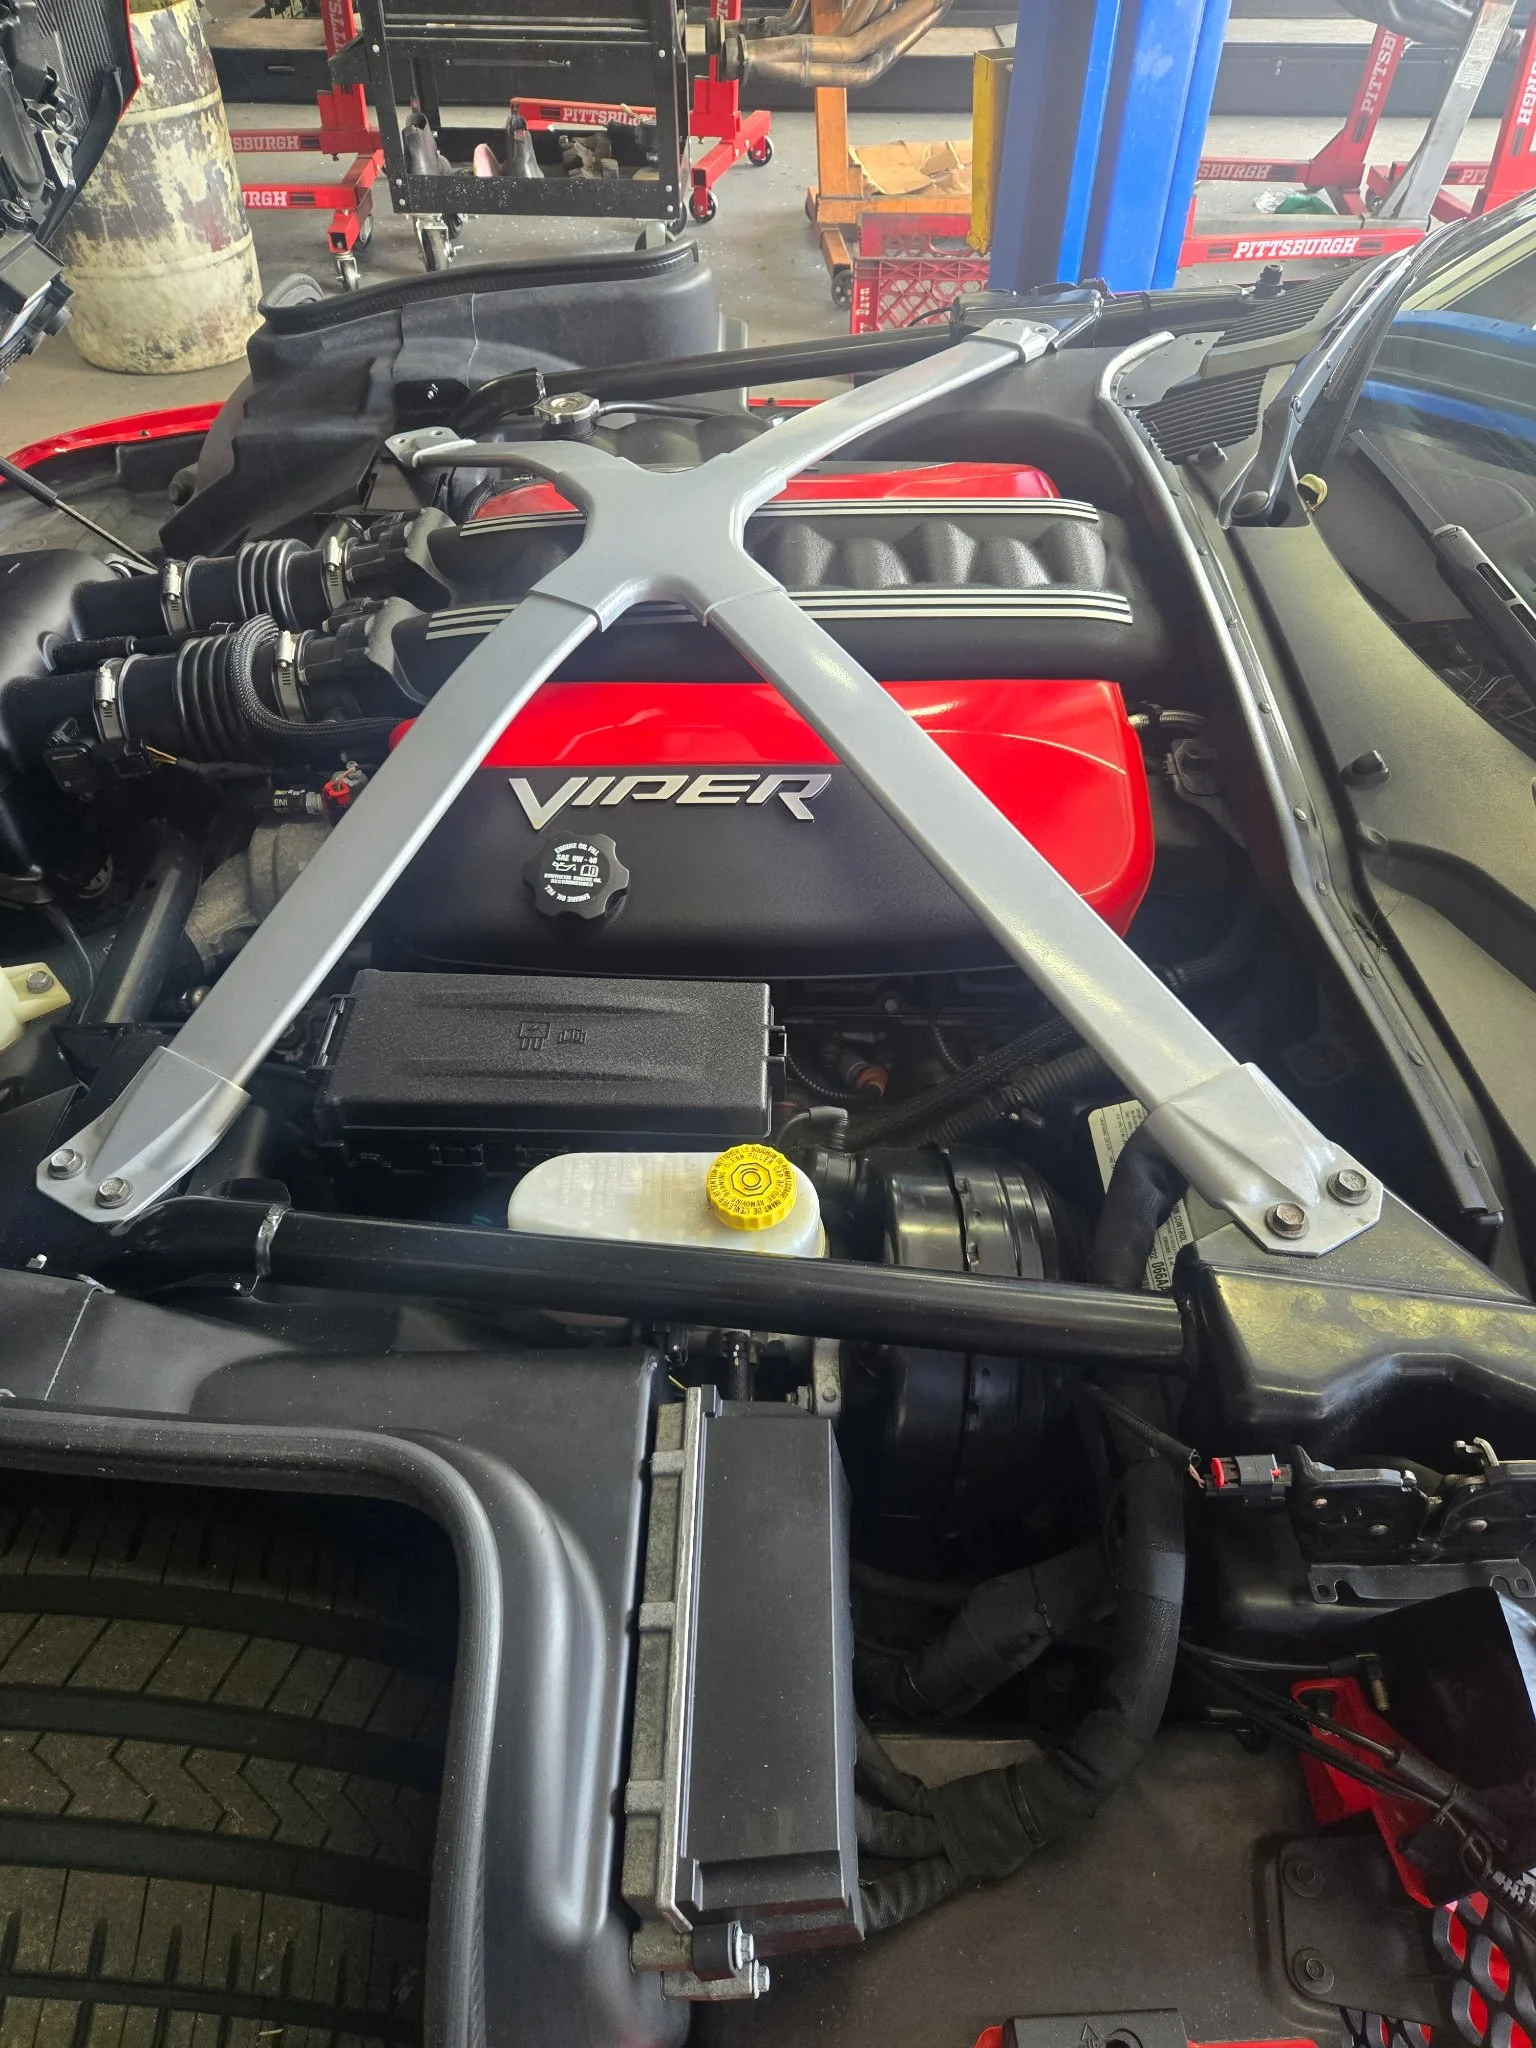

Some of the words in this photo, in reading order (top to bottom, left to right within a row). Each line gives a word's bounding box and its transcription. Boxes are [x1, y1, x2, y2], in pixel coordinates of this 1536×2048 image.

[1361, 30, 1398, 114] PITTSB
[1232, 237, 1360, 259] PITTSBURGH
[508, 773, 832, 831] VIPER
[554, 843, 577, 854] ENGINE
[588, 845, 600, 856] FILL
[748, 1152, 774, 1165] FILLER
[773, 1165, 784, 1178] CAP
[766, 1179, 785, 1202] BEFORE
[1173, 1215, 1187, 1242] CONTROL
